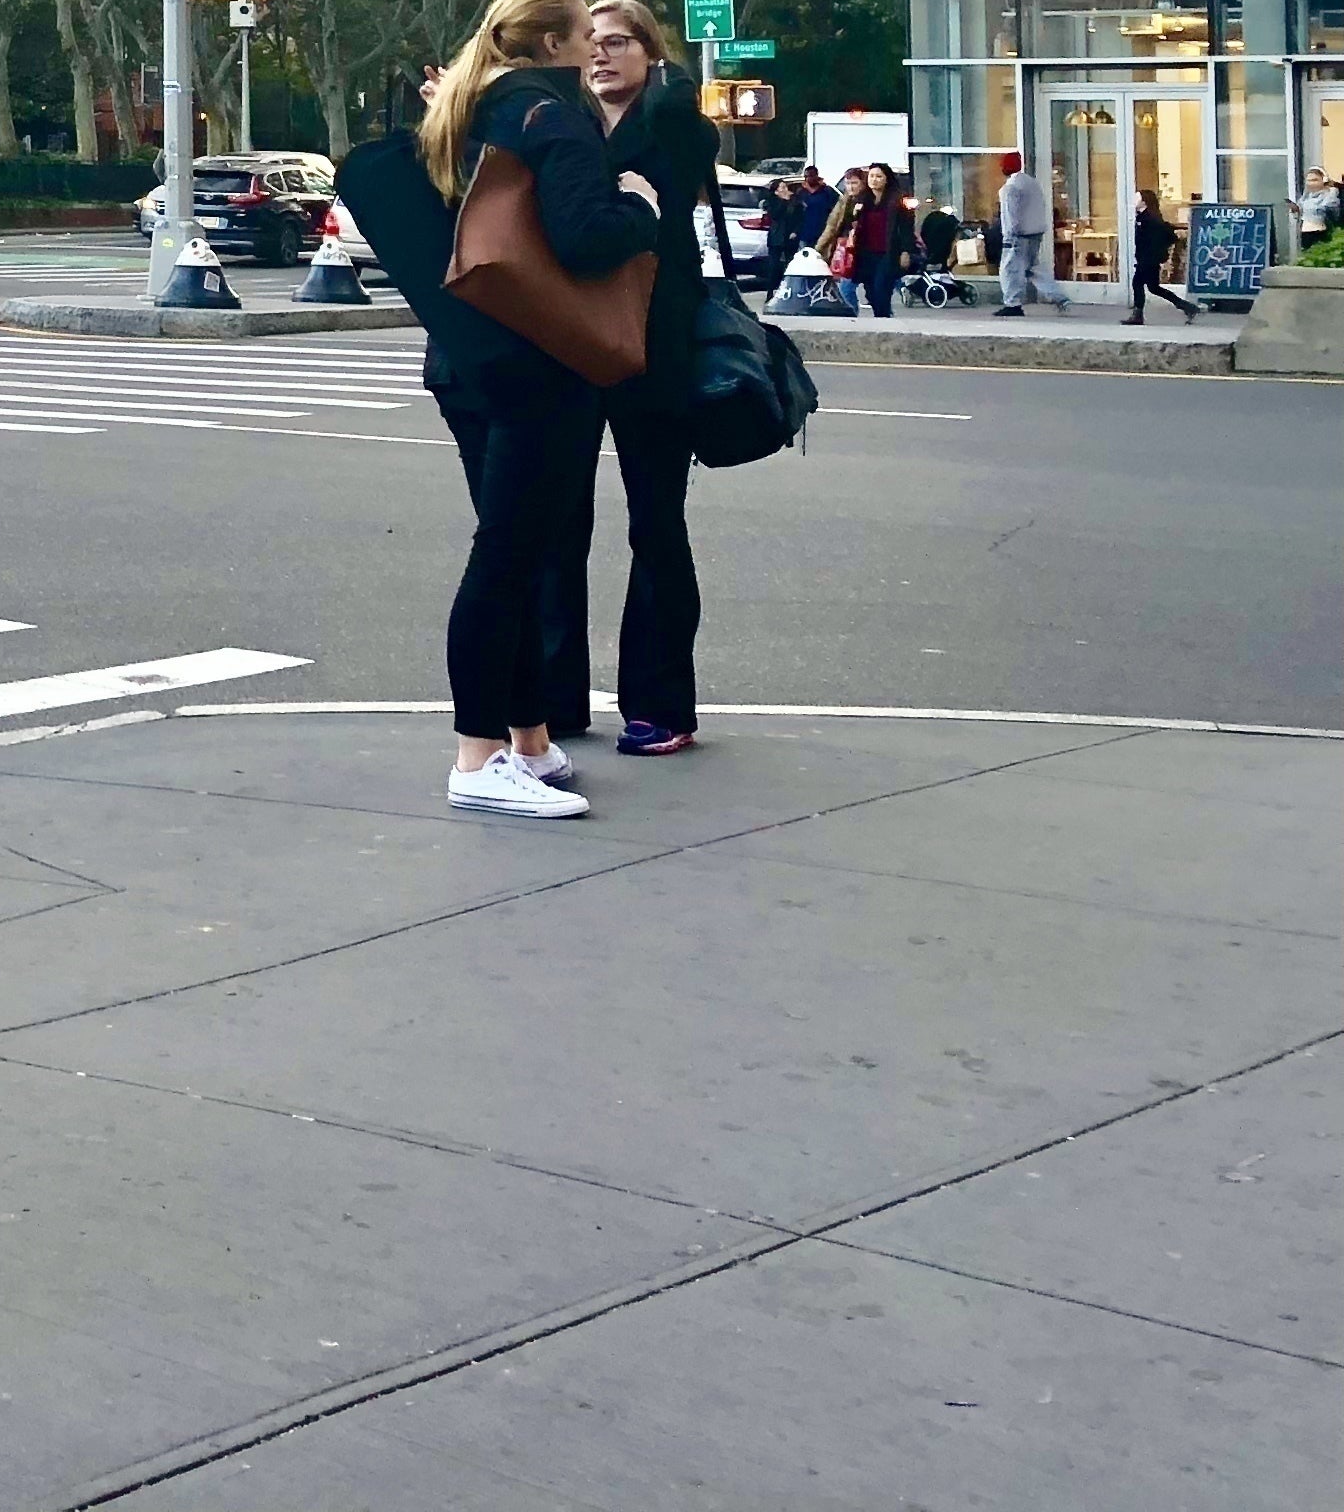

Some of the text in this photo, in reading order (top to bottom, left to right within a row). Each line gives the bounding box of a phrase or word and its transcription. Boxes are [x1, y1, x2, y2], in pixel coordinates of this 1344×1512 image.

[696, 9, 722, 18] Bridge
[724, 43, 769, 52] E Houston
[1205, 208, 1255, 219] ALLEGRO
[1197, 223, 1265, 246] MPLE
[1194, 245, 1265, 265] OTLY
[1194, 264, 1264, 289] LTTE
